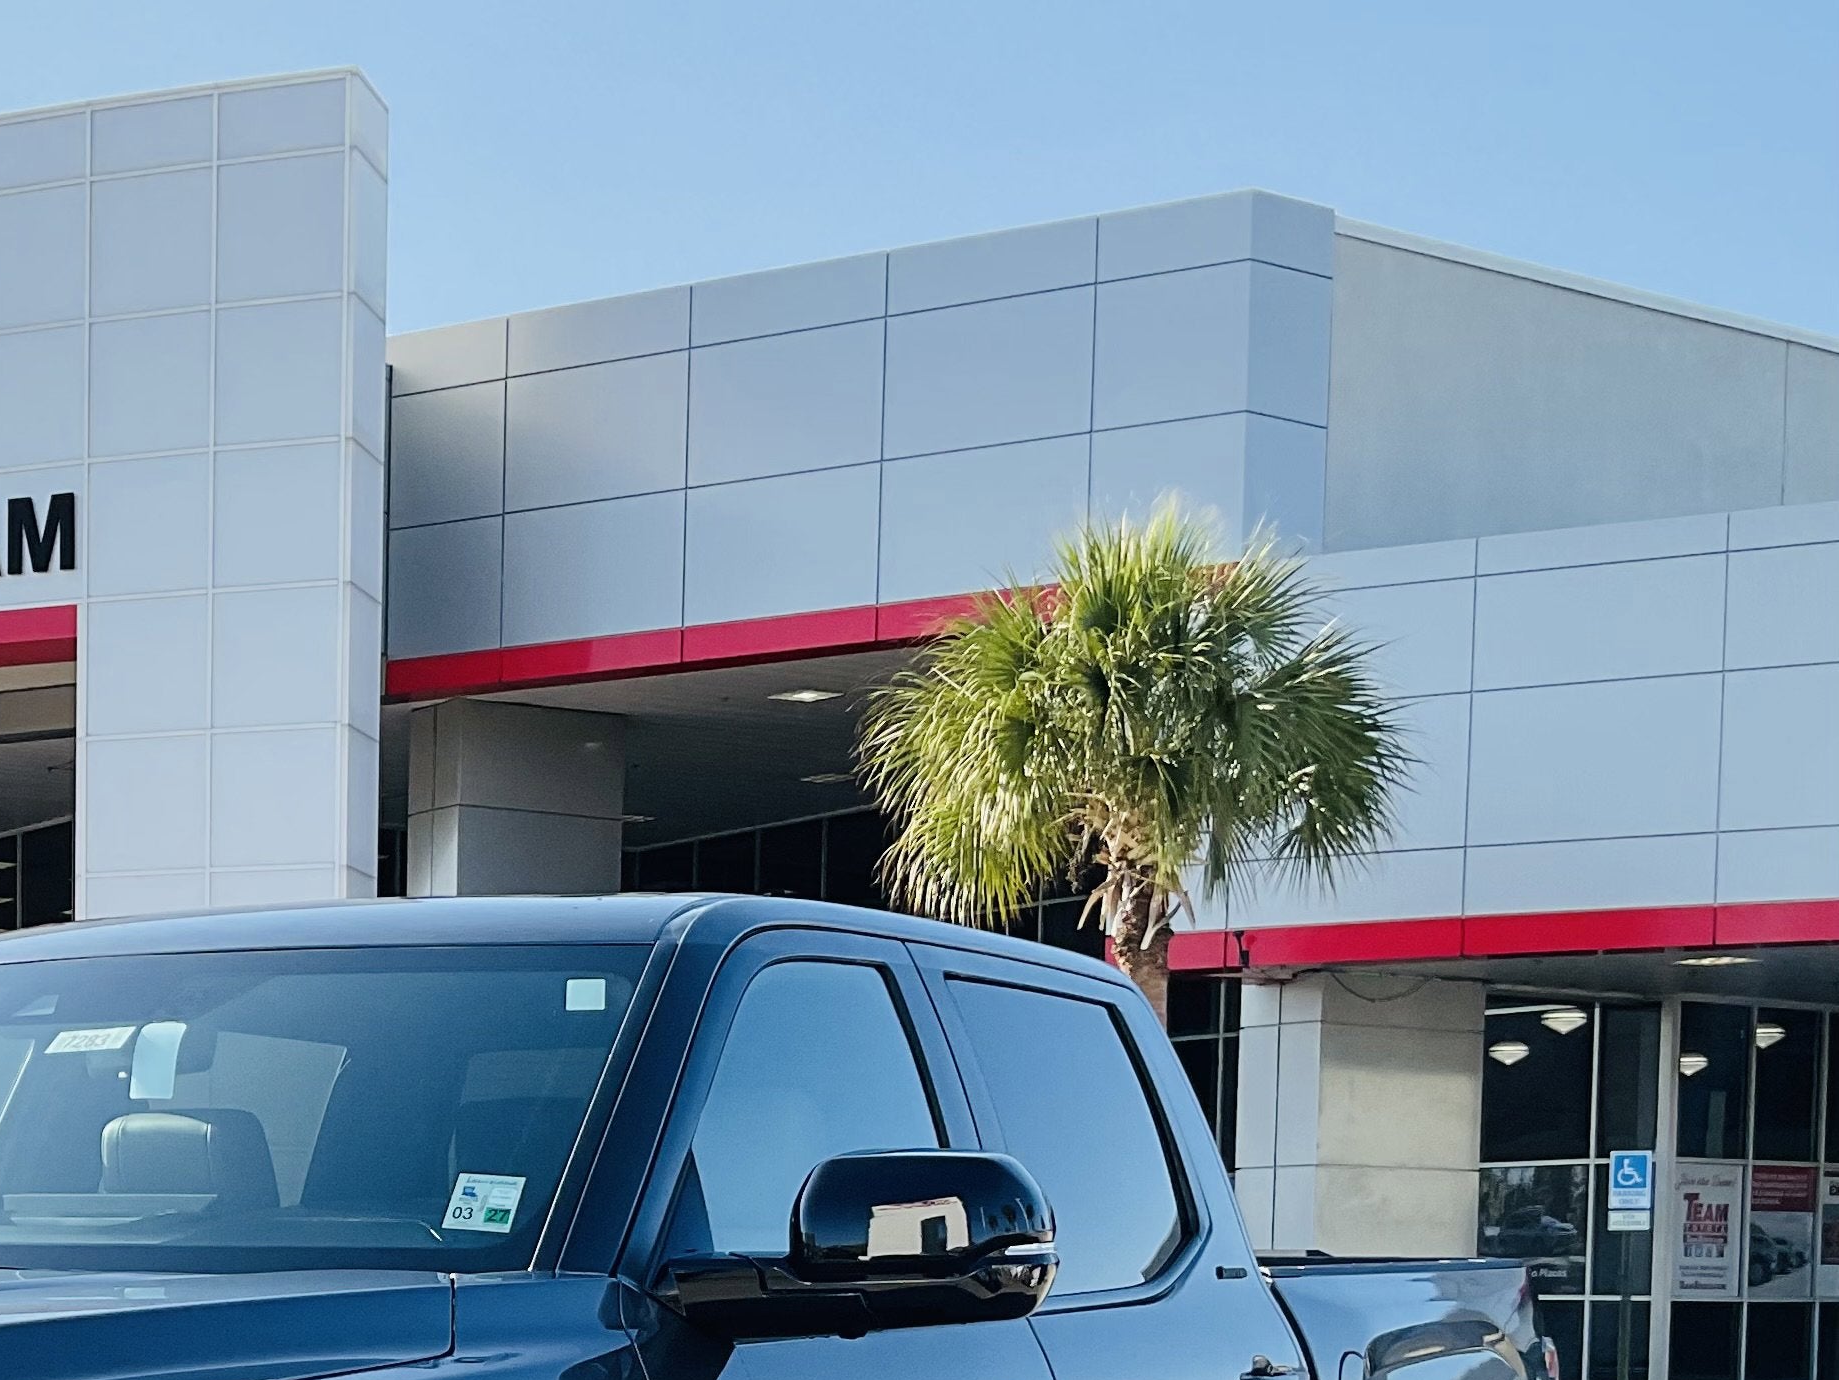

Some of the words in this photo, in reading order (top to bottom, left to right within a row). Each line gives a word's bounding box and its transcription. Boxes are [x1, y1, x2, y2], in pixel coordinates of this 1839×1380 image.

[452, 1206, 474, 1220] 03
[1683, 1192, 1729, 1222] TEAM
[486, 1208, 512, 1222] 27
